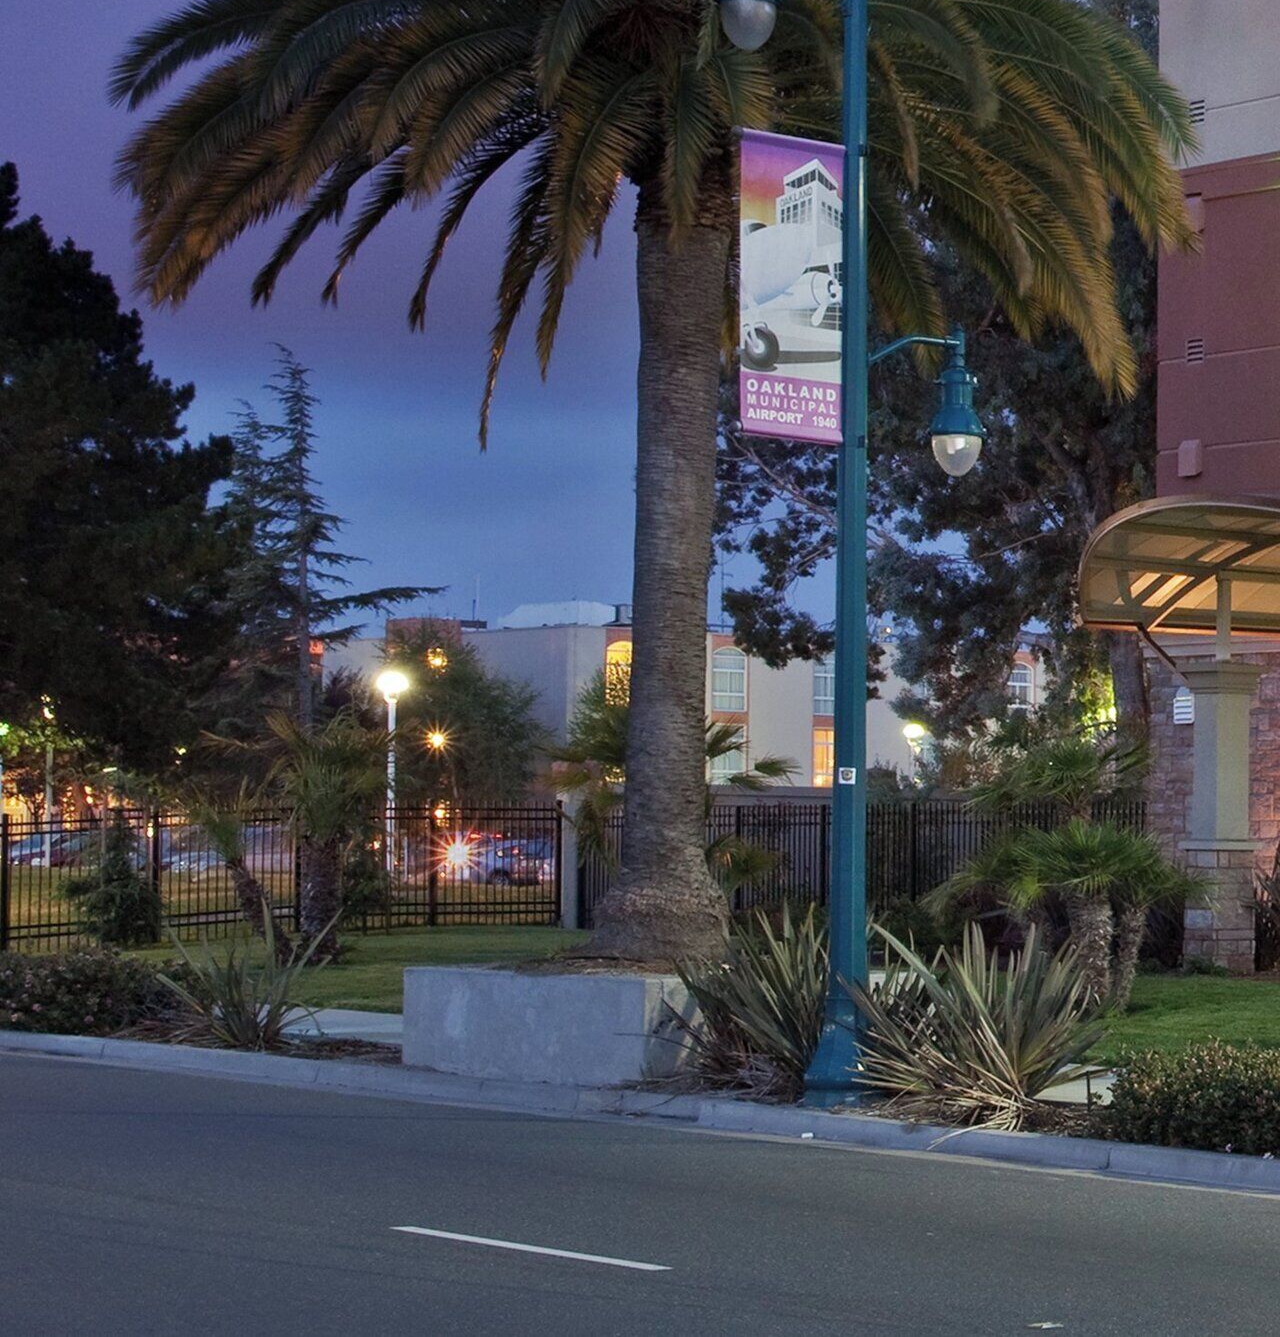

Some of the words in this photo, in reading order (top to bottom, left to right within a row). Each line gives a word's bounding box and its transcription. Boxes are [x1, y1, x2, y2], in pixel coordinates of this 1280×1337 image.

[746, 378, 837, 402] OAKLAND
[746, 393, 837, 415] MUNICIPAL
[747, 408, 803, 425] AIRPORT
[812, 416, 837, 429] 1940
